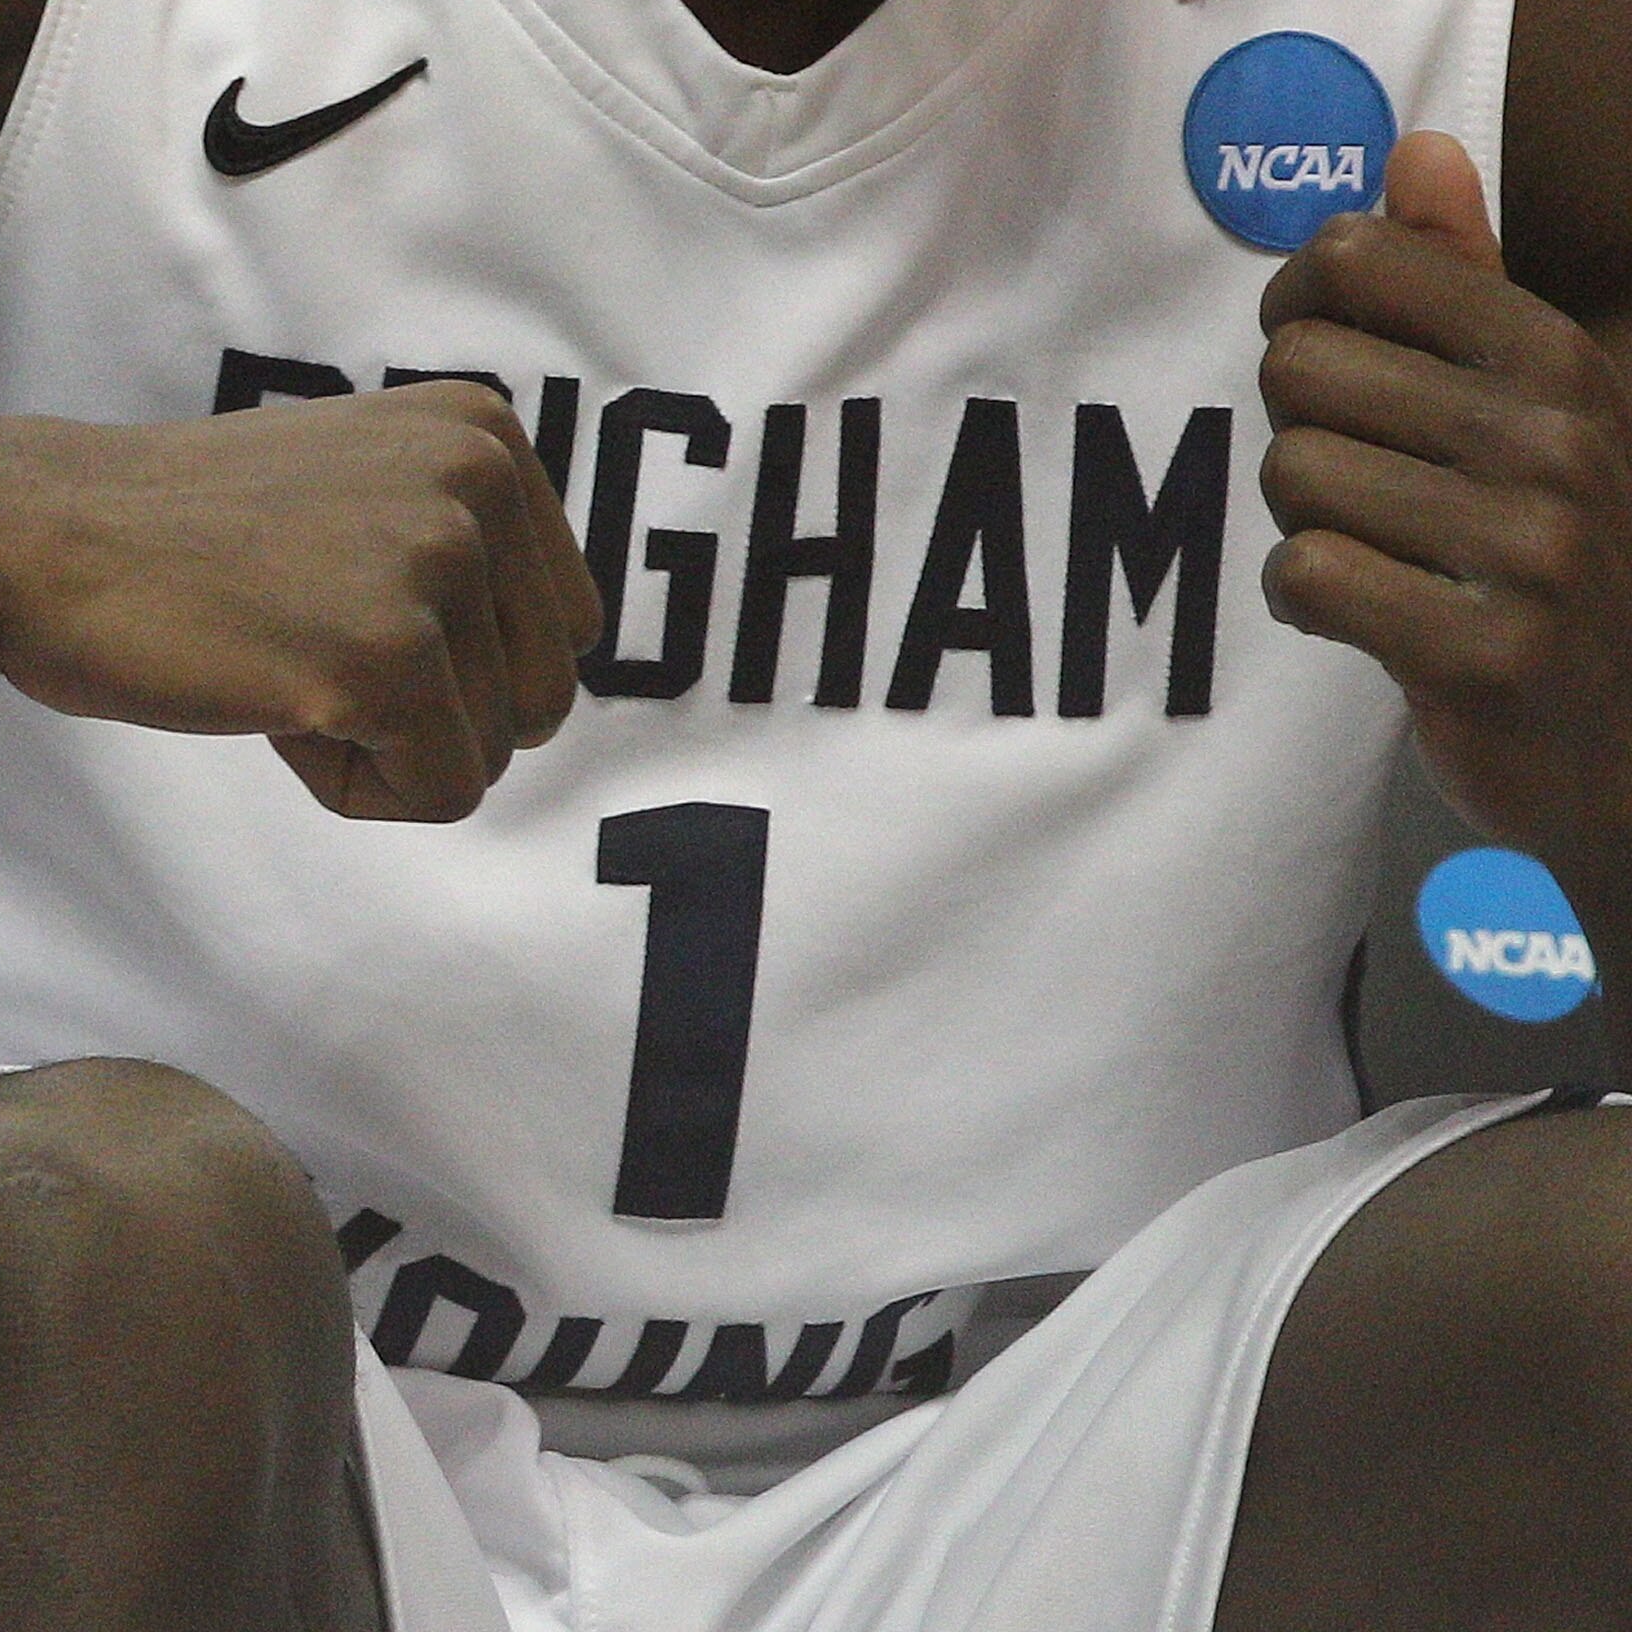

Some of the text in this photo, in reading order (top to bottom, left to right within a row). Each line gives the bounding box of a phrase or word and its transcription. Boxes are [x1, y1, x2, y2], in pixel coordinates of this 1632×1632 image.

[1216, 144, 1365, 192] NCAA
[211, 348, 1233, 718] GHAM
[596, 801, 770, 1220] 1
[1445, 928, 1596, 982] NCAA
[336, 1207, 954, 1402] OUNG
